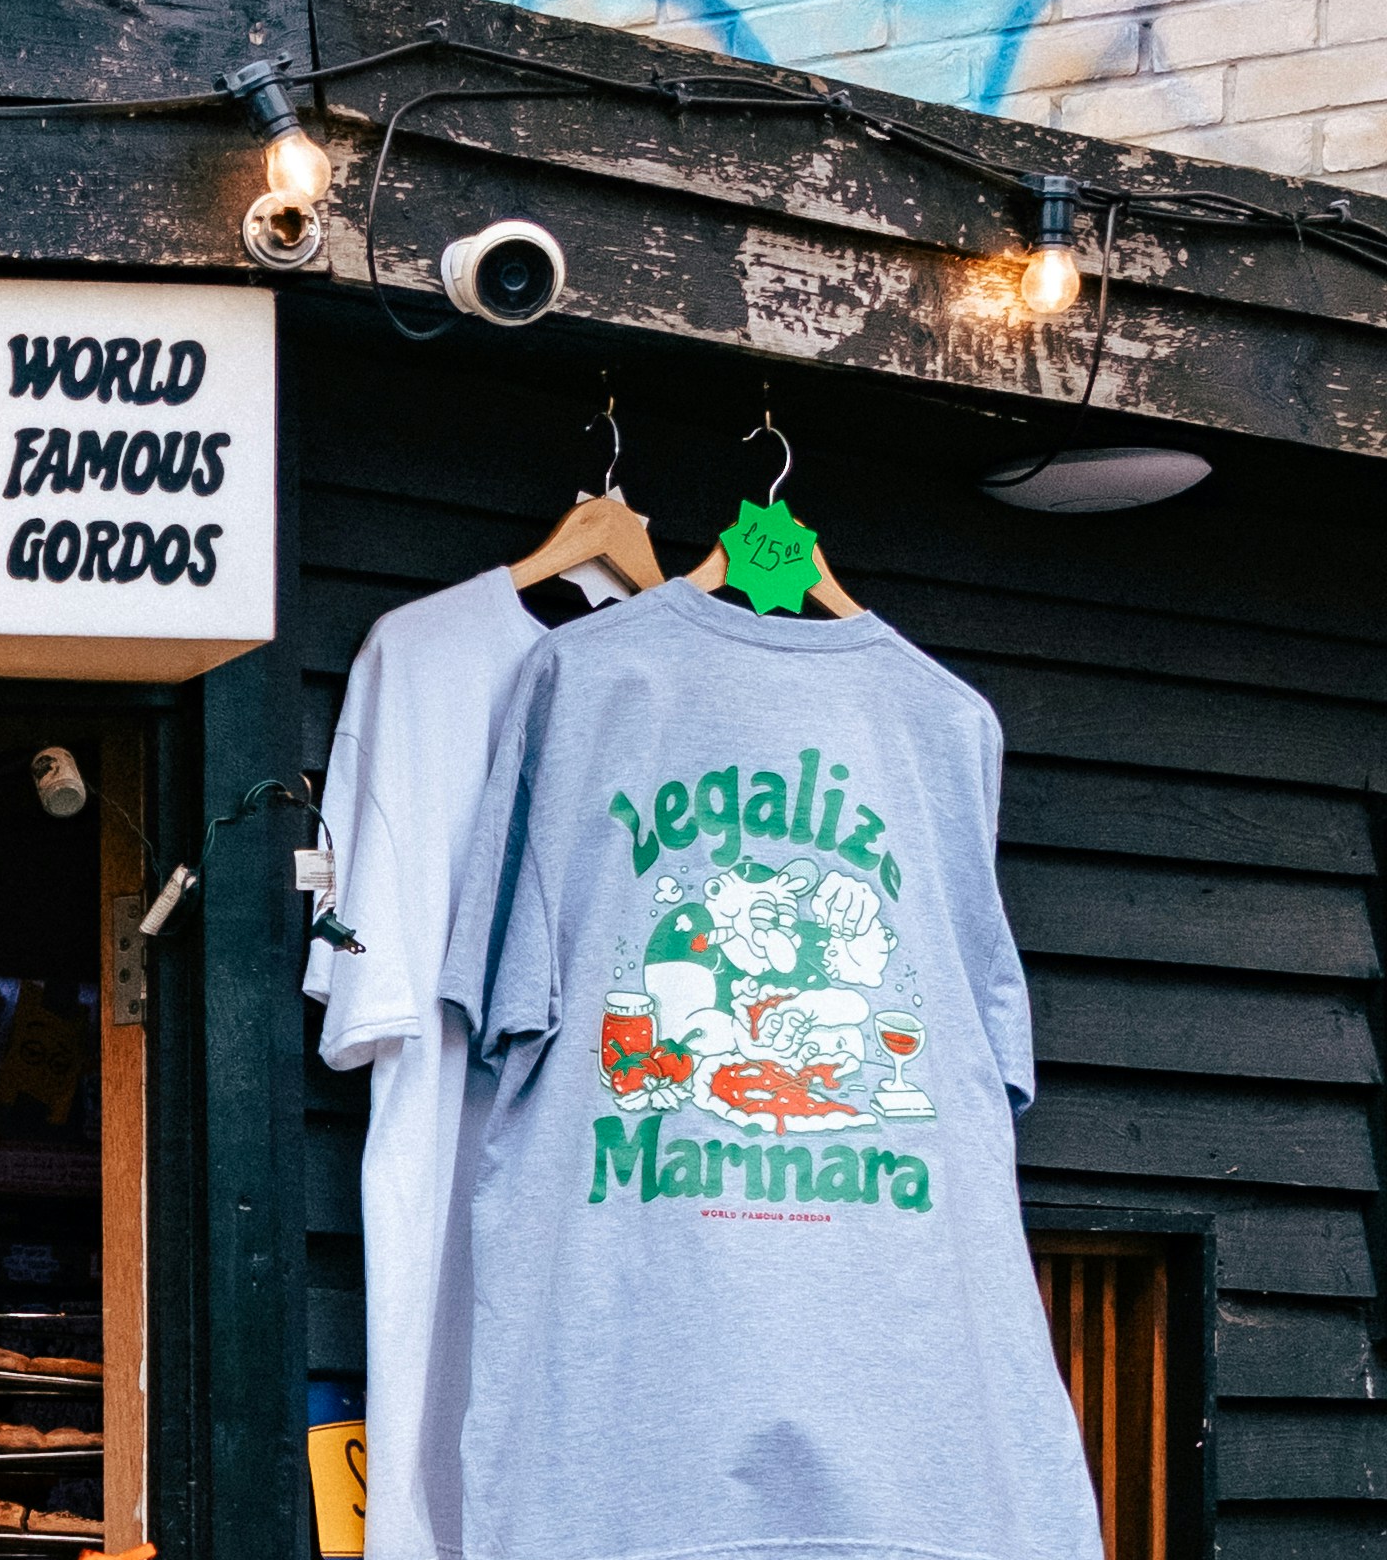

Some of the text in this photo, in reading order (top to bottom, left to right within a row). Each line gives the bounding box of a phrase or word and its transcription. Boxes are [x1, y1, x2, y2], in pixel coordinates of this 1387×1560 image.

[8, 334, 206, 405] WORLD
[2, 428, 231, 499] FAMOUS
[7, 518, 223, 587] GORDOS
[587, 1115, 934, 1213] Marinara
[700, 1209, 737, 1220] WORLD
[742, 1211, 784, 1221] FAMOUS
